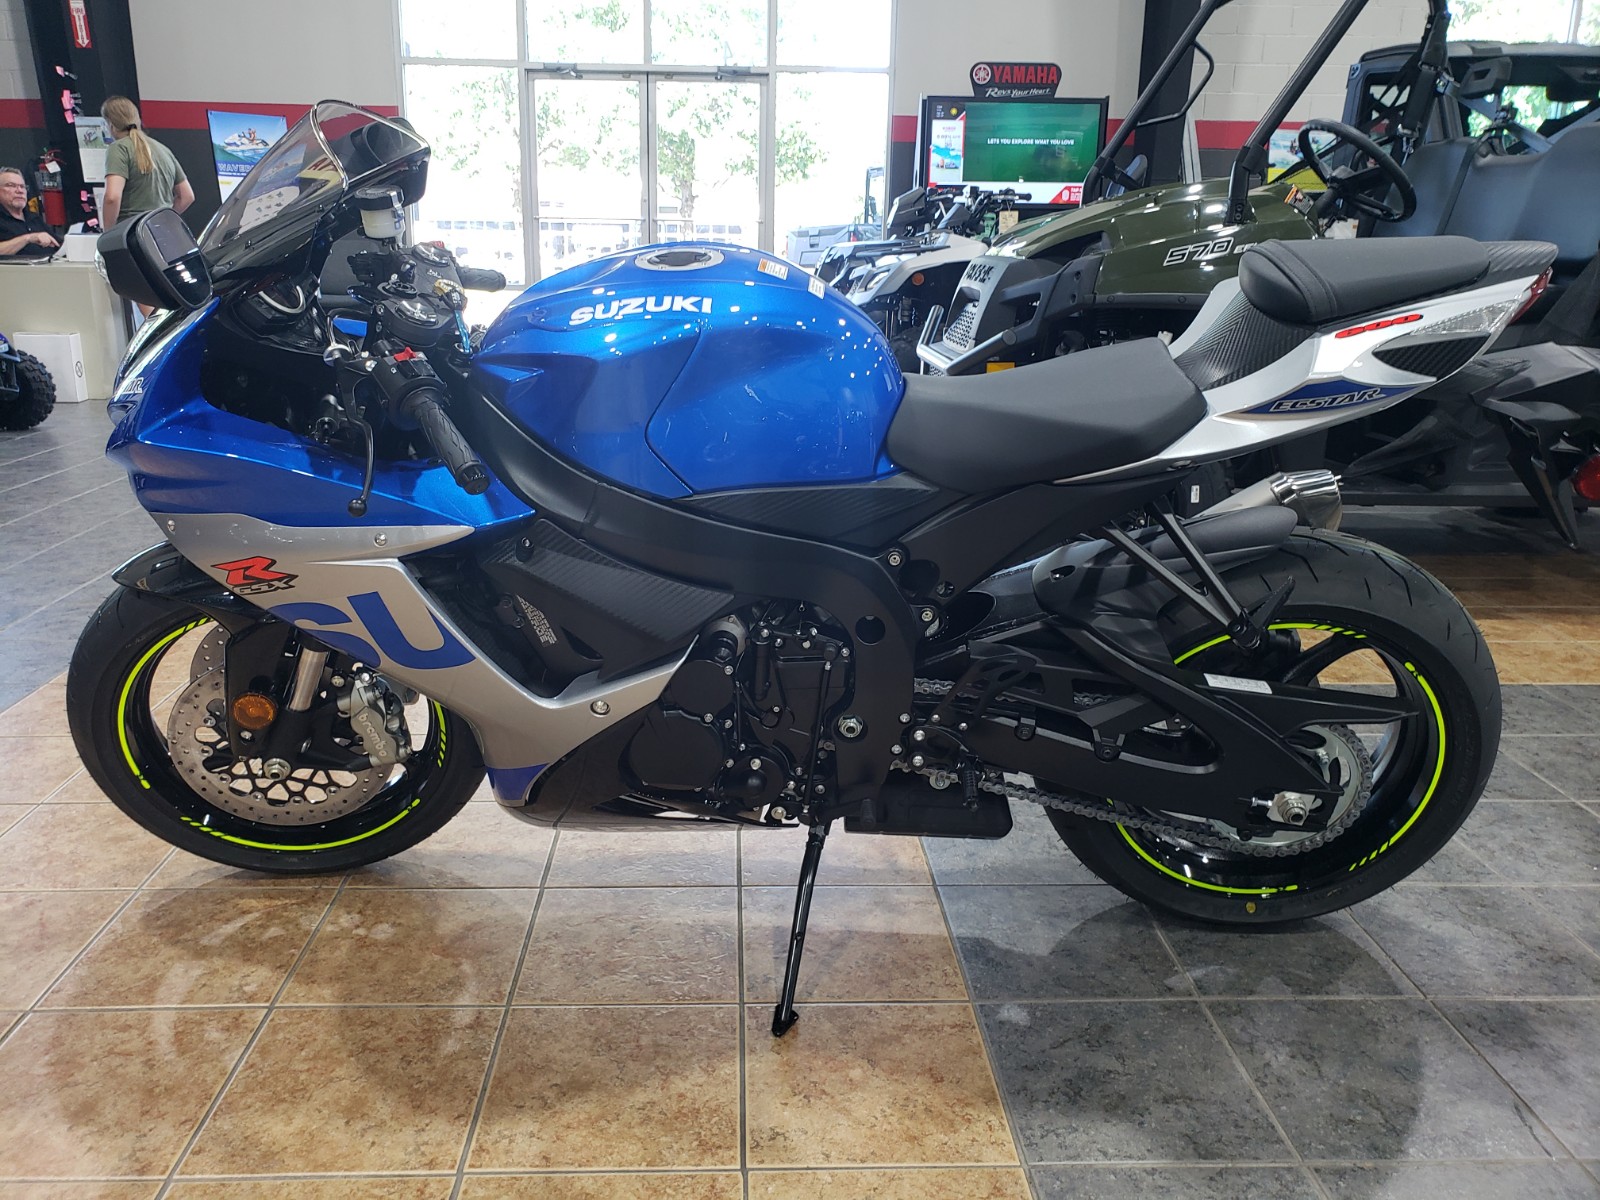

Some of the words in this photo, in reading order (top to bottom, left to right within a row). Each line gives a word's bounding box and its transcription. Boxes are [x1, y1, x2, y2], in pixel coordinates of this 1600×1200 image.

[993, 65, 1058, 84] YAMAHA
[985, 87, 1011, 98] Revs
[1011, 88, 1029, 98] Your
[1030, 87, 1051, 96] Heart
[1163, 237, 1234, 266] 570
[568, 295, 712, 326] SUZUKI
[1268, 387, 1387, 412] ECSTAR
[231, 579, 296, 596] GSX
[357, 712, 388, 758] brembo
